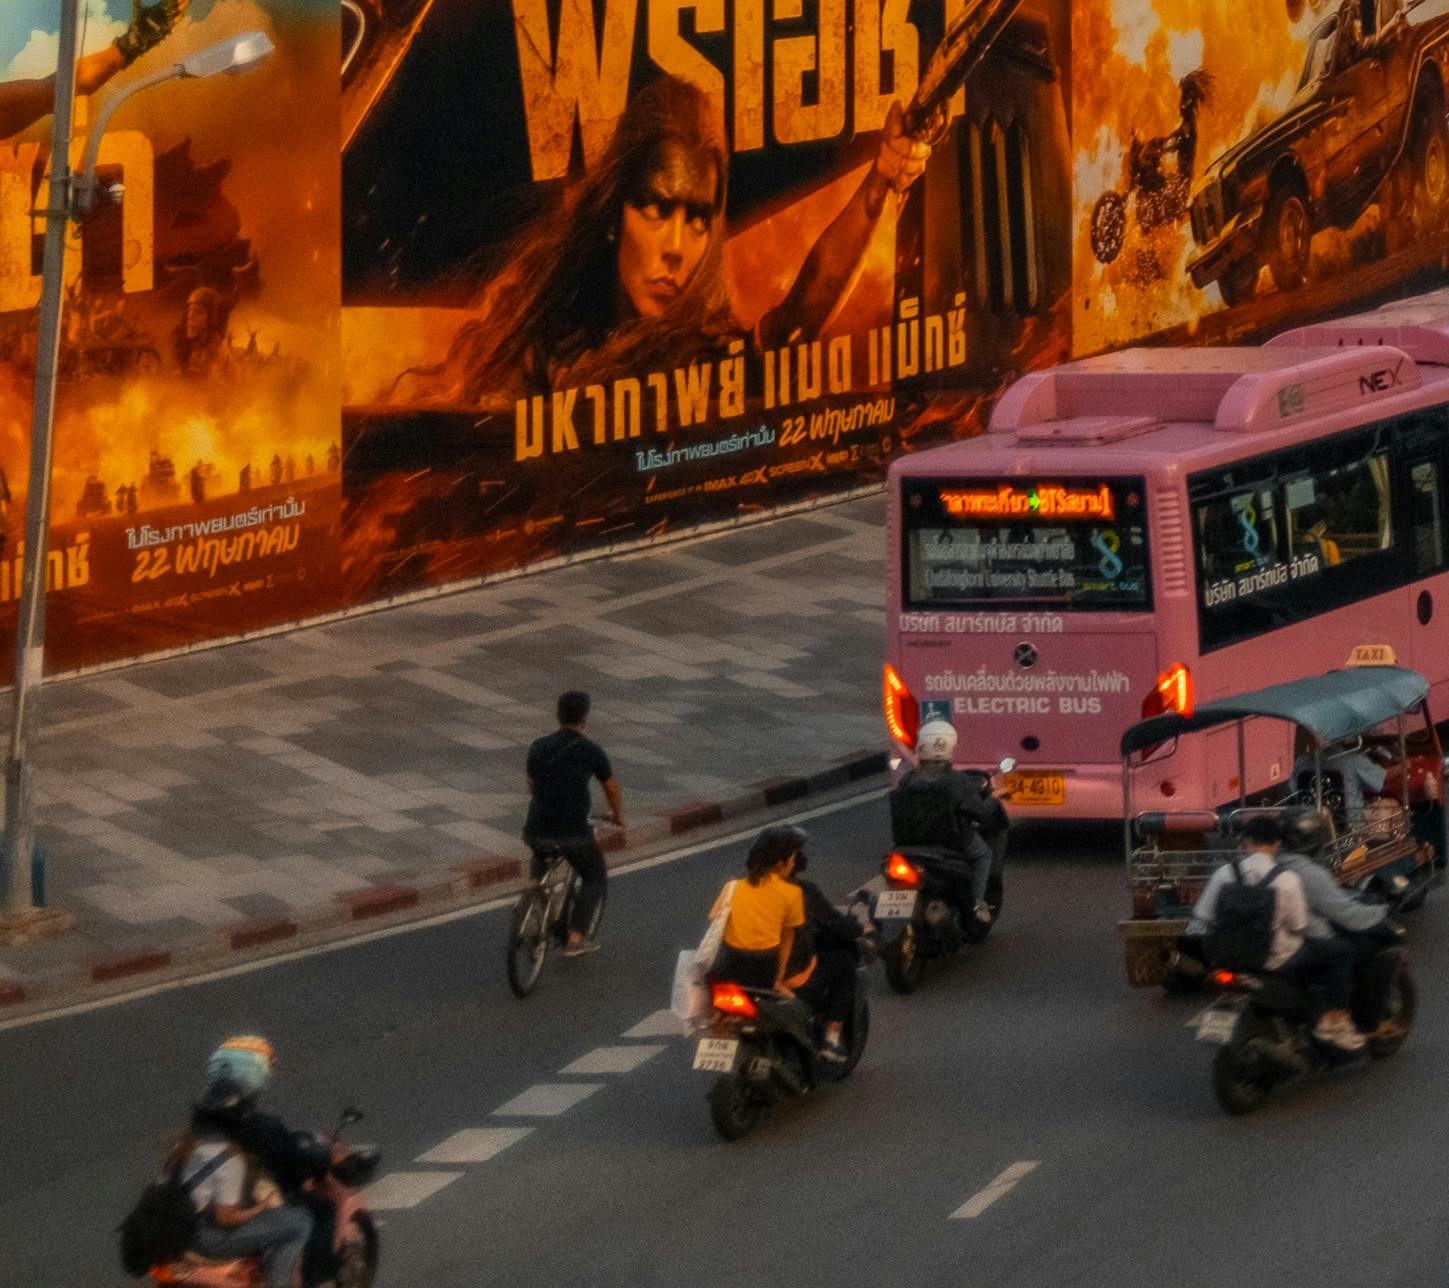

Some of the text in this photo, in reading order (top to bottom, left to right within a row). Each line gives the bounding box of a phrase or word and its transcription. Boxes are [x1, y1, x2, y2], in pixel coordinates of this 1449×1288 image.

[515, 340, 746, 462] มหากาพย์
[869, 292, 967, 386] แม็กซ์
[1359, 356, 1404, 396] NEX
[779, 418, 806, 448] 22
[809, 398, 896, 446] พฤษภาคม
[704, 476, 736, 493] IMAX
[131, 524, 301, 584] 22 พฤษภาคม
[1205, 578, 1236, 607] บริษัท
[1289, 553, 1319, 580] จำกัด
[1023, 612, 1063, 632] จำกัด
[1355, 648, 1386, 661] TAXI
[954, 697, 1101, 715] ELECTRIC BUS
